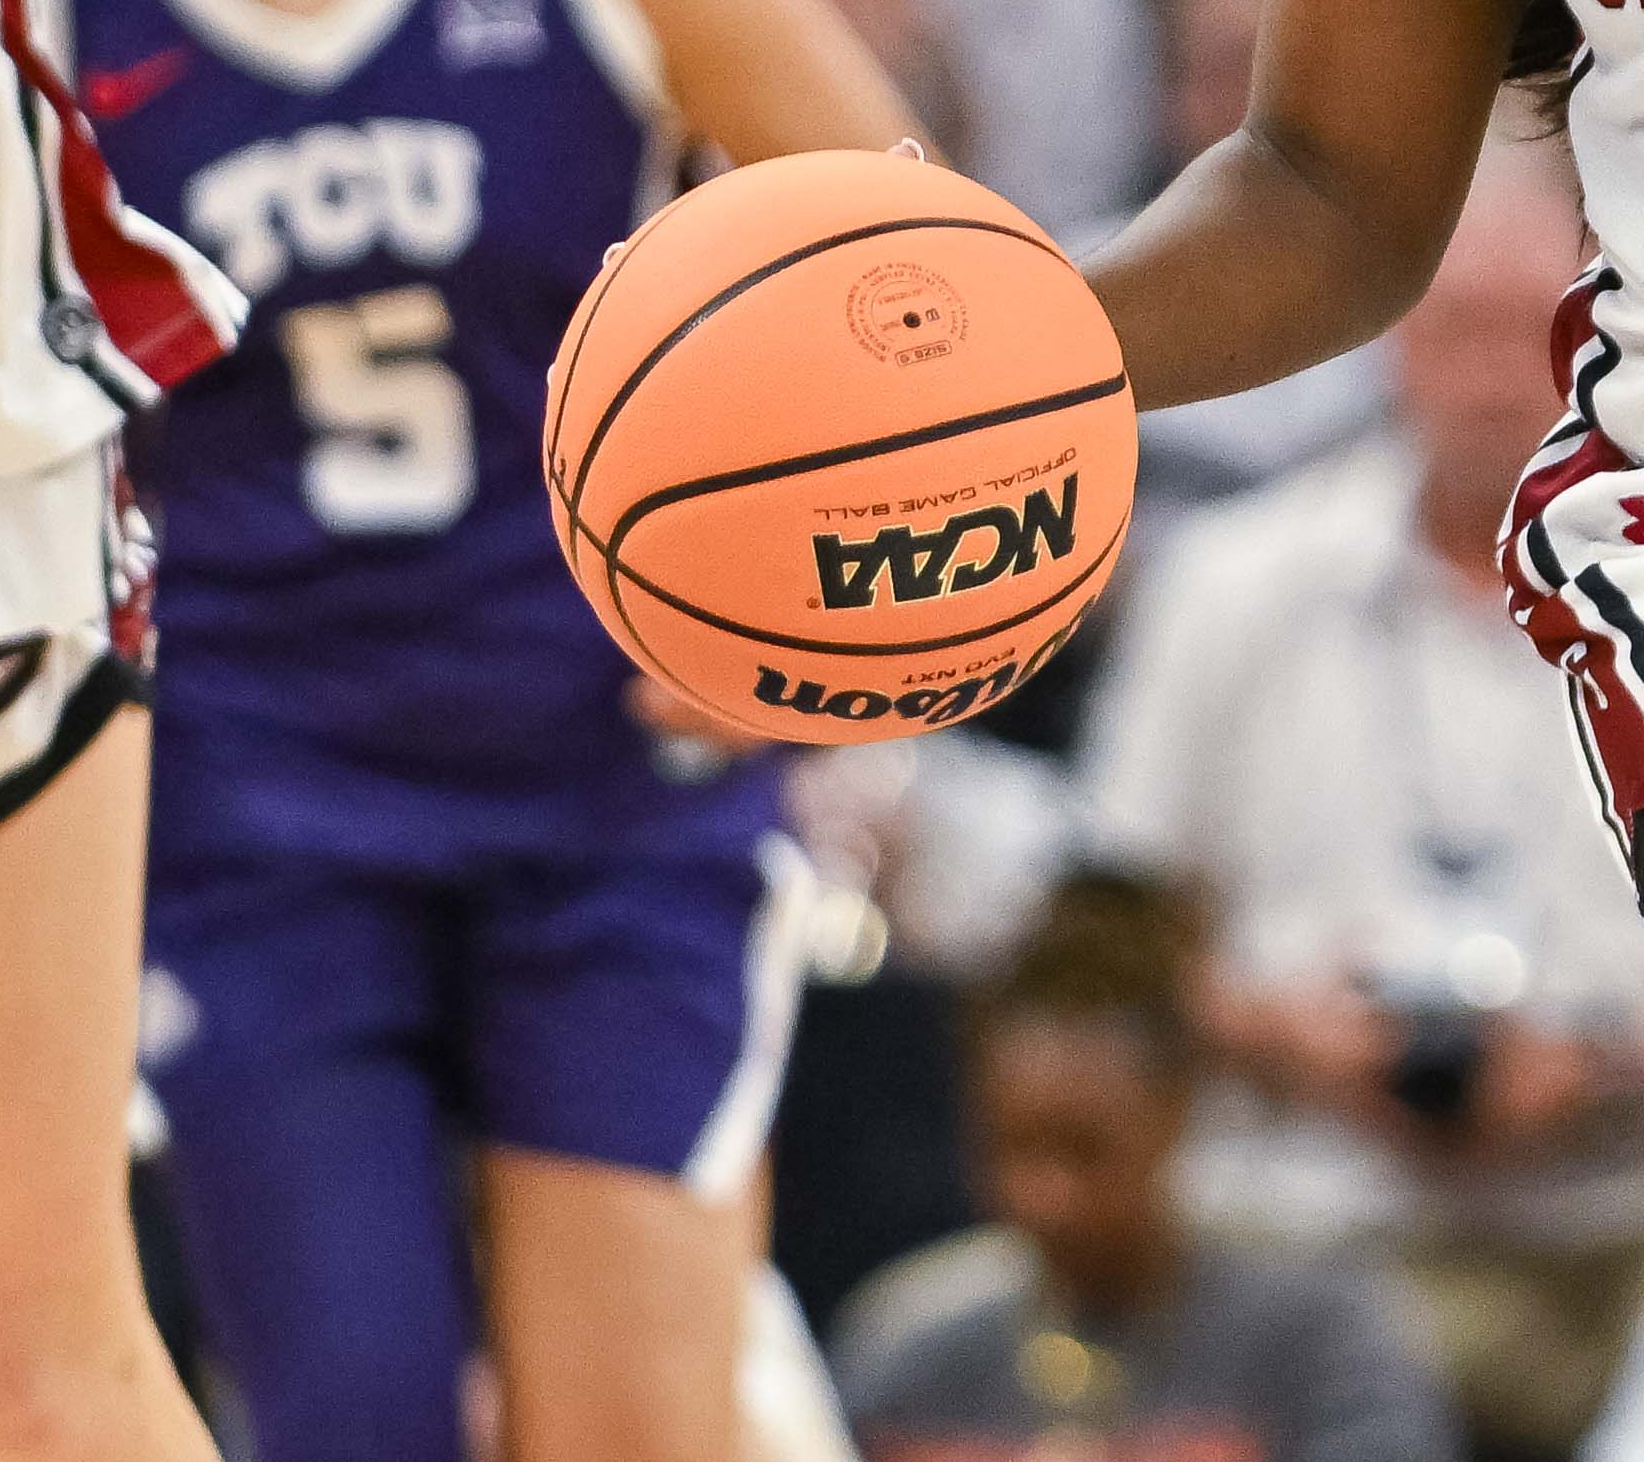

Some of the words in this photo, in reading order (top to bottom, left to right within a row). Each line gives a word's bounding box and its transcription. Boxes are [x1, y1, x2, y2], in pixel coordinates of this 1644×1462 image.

[182, 115, 484, 298] TCU
[278, 281, 478, 536] 5
[814, 503, 891, 522] BALL
[899, 486, 978, 514] GAME
[984, 447, 1077, 491] OFFICIAL
[811, 470, 1079, 611] NCAA
